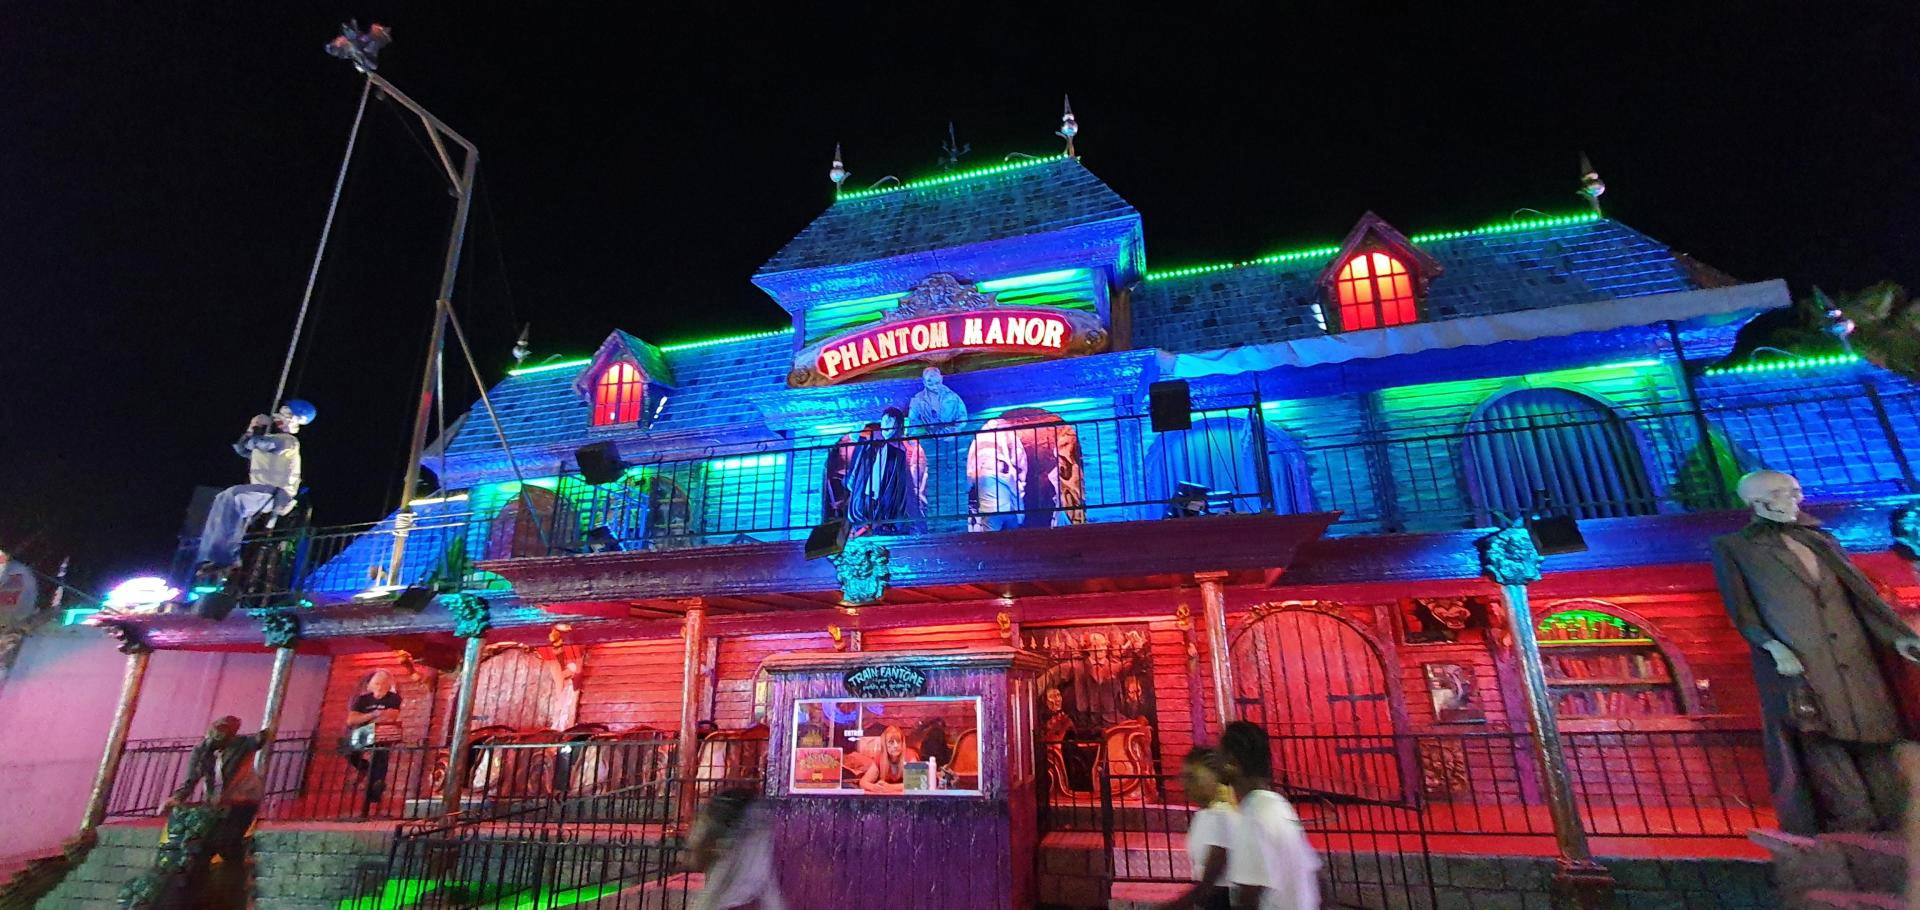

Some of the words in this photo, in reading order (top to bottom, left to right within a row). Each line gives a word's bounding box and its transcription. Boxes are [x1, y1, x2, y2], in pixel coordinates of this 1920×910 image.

[823, 321, 950, 377] PHANTOM
[963, 317, 1064, 348] MANOR
[848, 667, 877, 687] TRAIN
